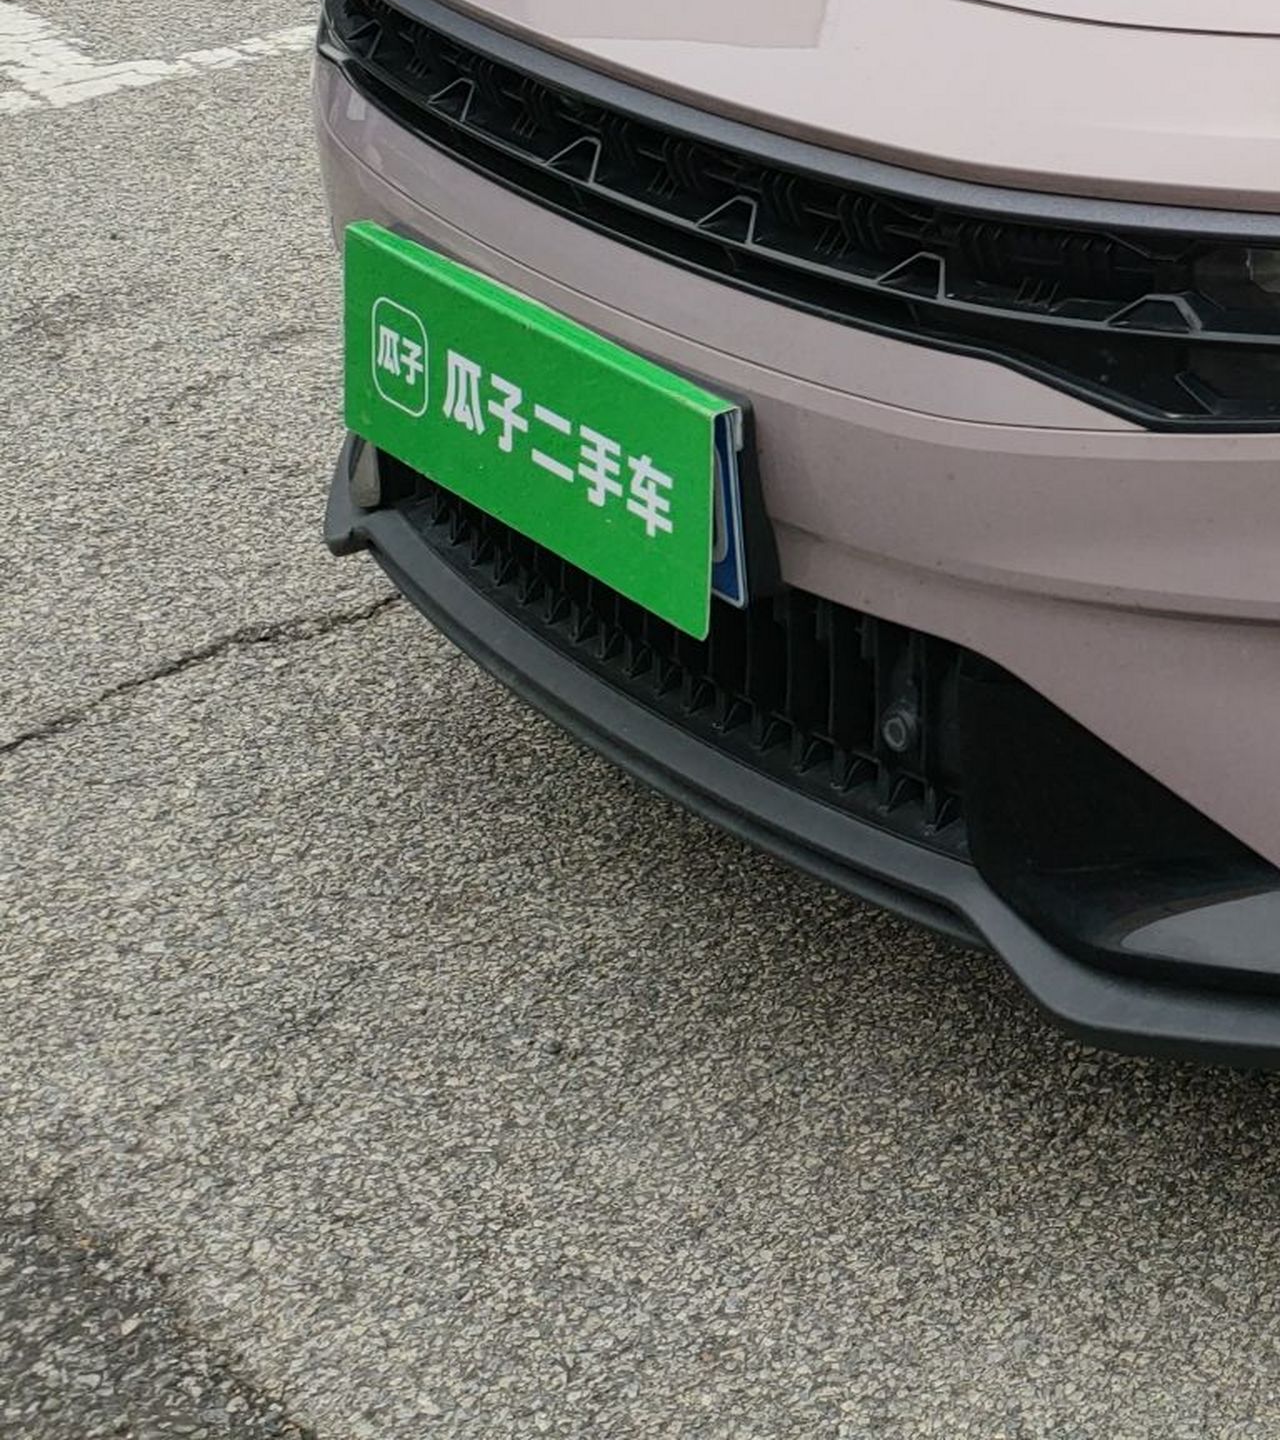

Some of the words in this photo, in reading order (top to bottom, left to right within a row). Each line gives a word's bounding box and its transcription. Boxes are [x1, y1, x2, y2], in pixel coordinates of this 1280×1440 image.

[376, 323, 425, 386] 瓜子
[441, 348, 674, 538] 瓜子二手车
